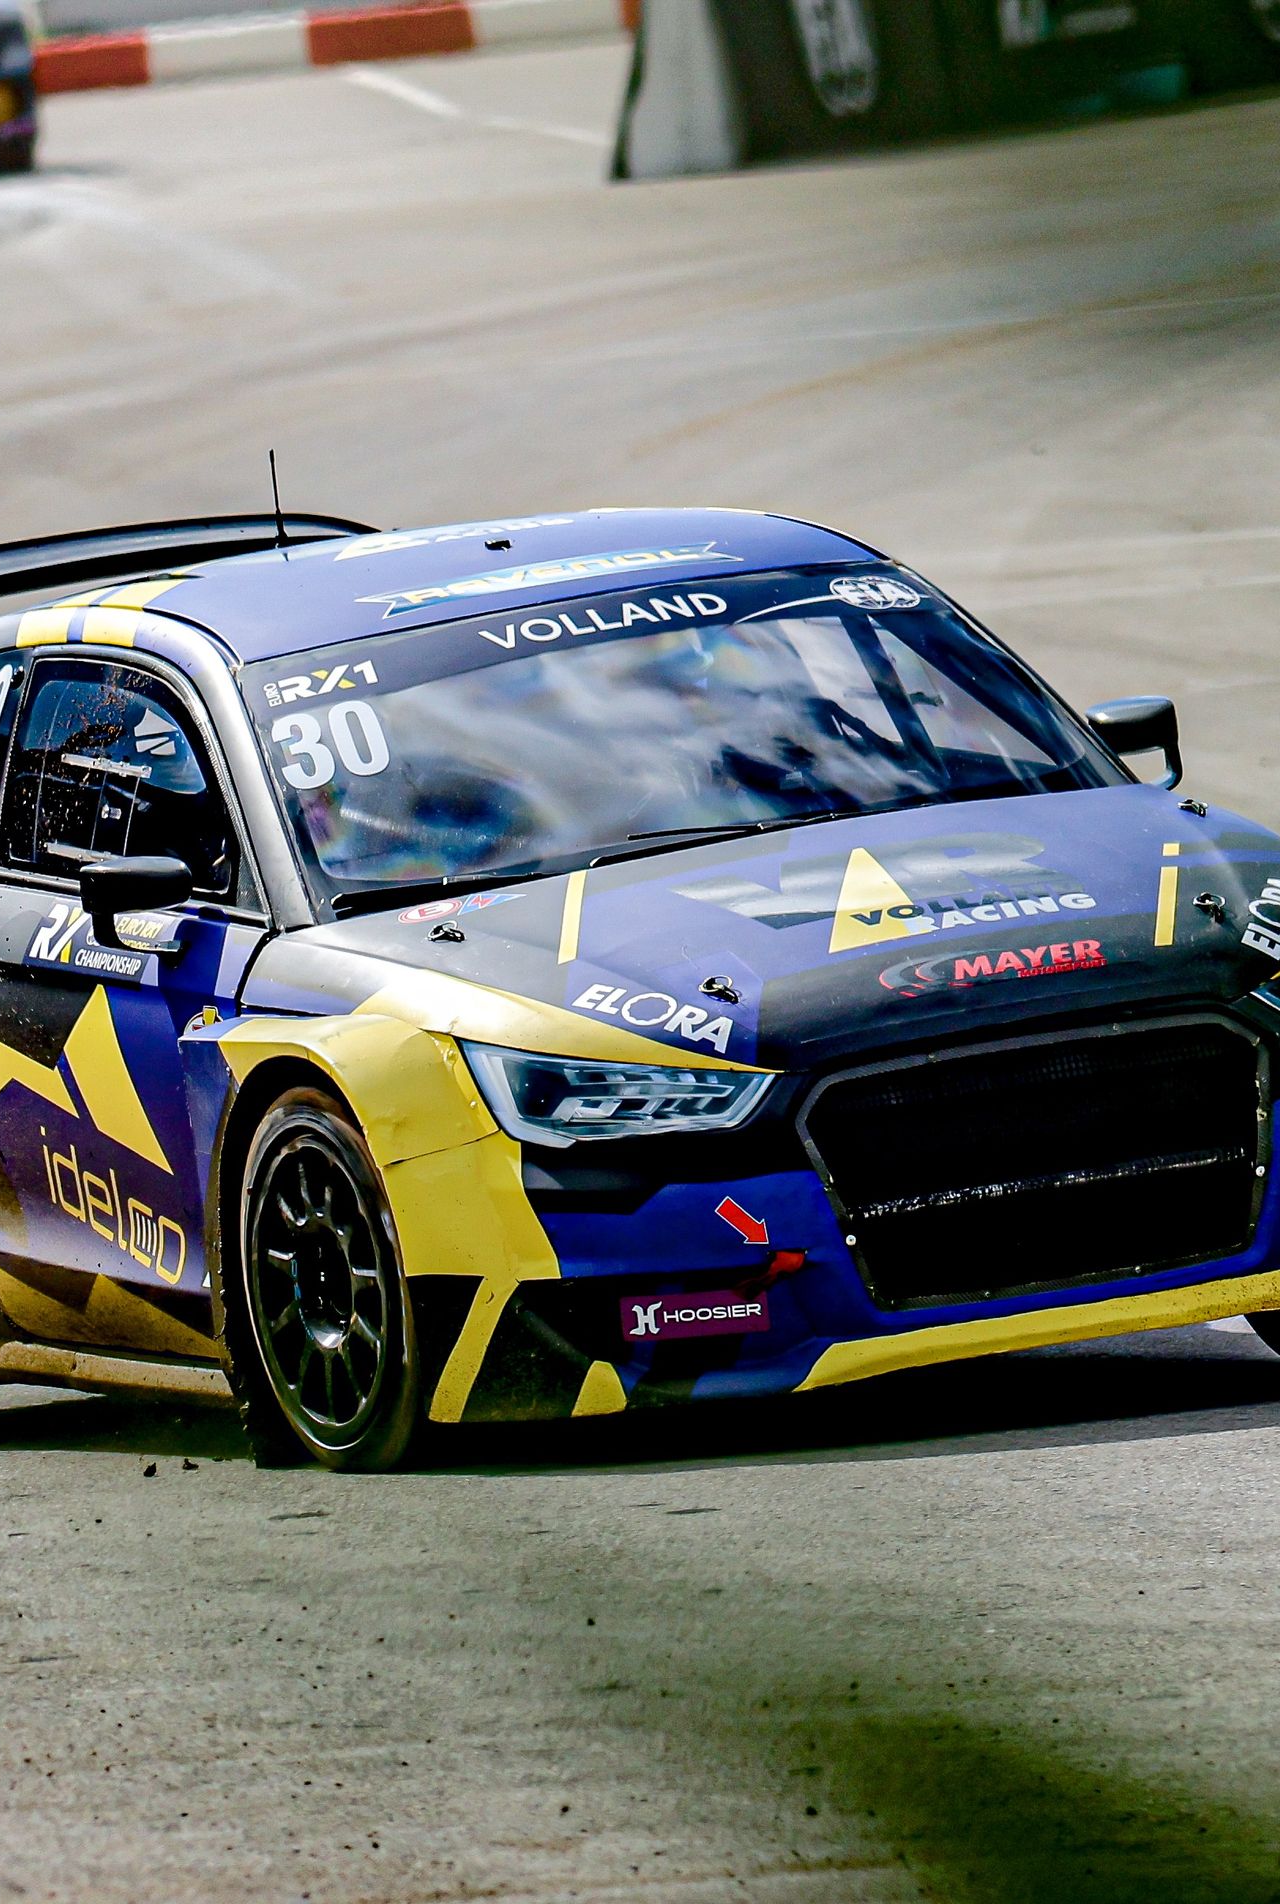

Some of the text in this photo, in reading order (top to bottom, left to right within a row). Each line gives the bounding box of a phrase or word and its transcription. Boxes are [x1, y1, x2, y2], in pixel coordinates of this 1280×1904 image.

[403, 550, 700, 604] RAVENOL
[833, 582, 917, 605] FIA
[478, 593, 727, 649] VOLLAND
[263, 660, 379, 708] EURO RX1
[271, 700, 390, 790] 30
[28, 903, 92, 964] RX
[417, 903, 444, 918] E
[902, 892, 1096, 936] RACING
[74, 949, 142, 976] CHAMPIONSHIP
[954, 939, 1105, 980] MAYER
[572, 983, 734, 1054] ELORA
[663, 1303, 762, 1324] HOOSIER
